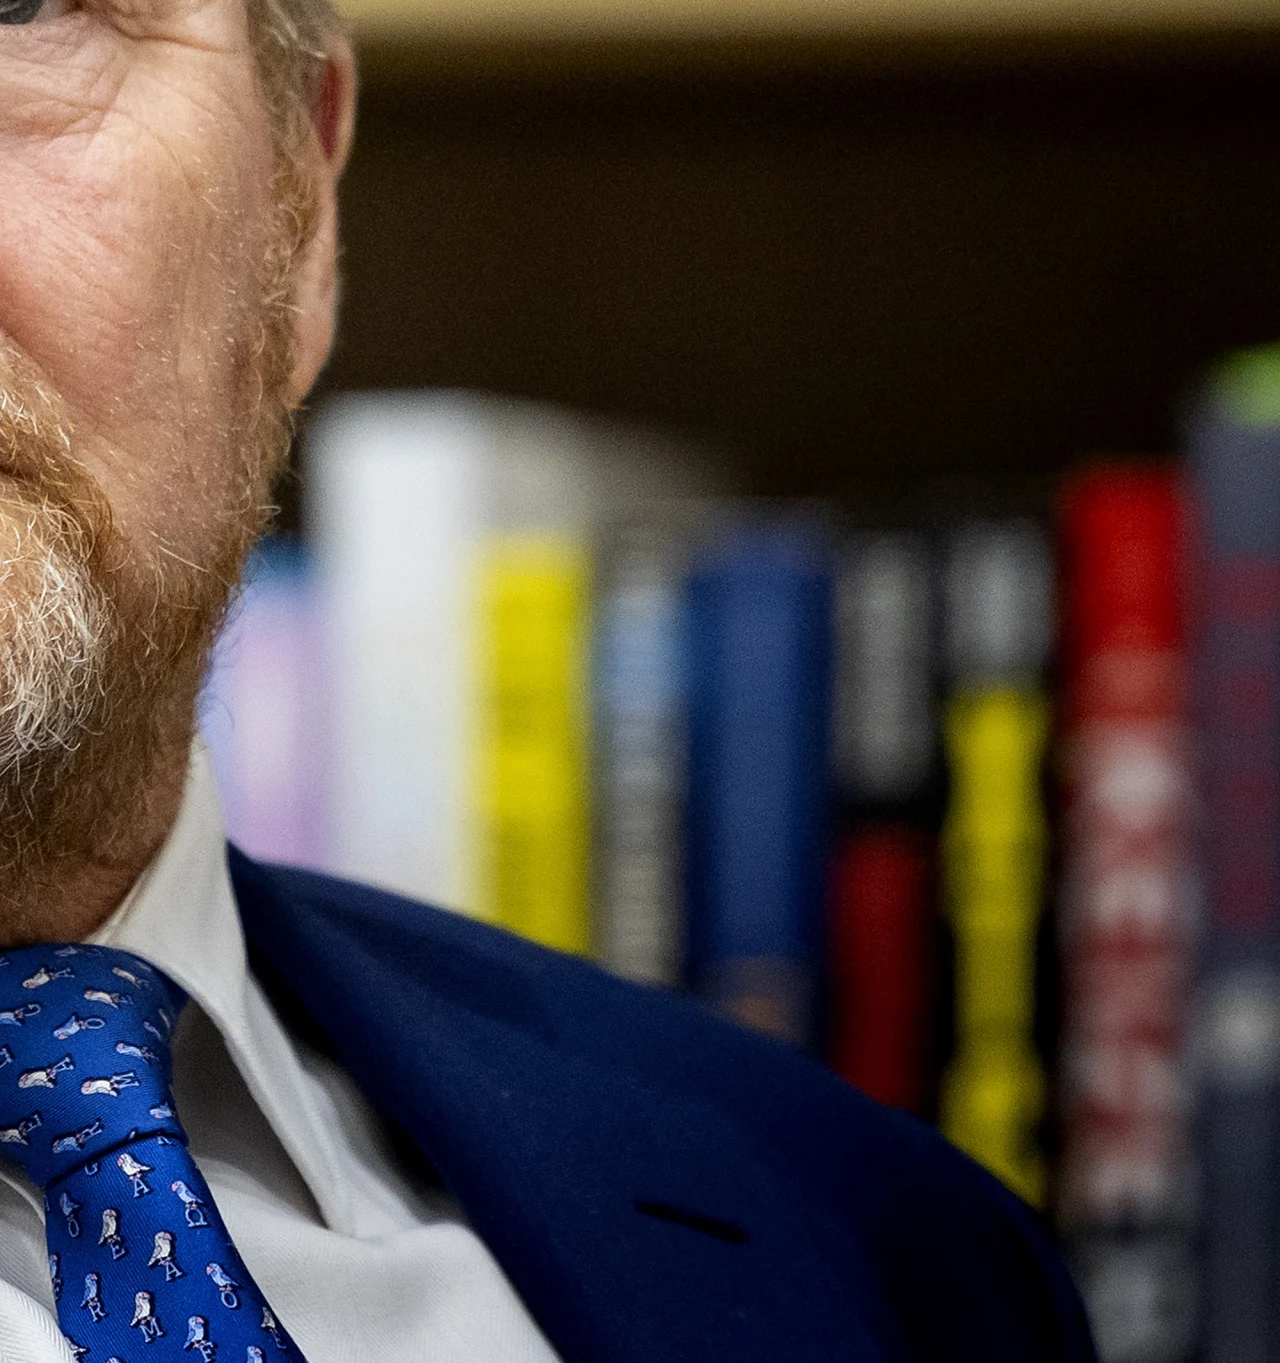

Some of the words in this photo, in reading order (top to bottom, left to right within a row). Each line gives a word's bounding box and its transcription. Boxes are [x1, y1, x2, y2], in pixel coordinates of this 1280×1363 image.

[133, 1178, 151, 1198] A
[165, 1261, 183, 1281] A
[220, 1290, 238, 1309] O
[140, 1317, 164, 1343] M
